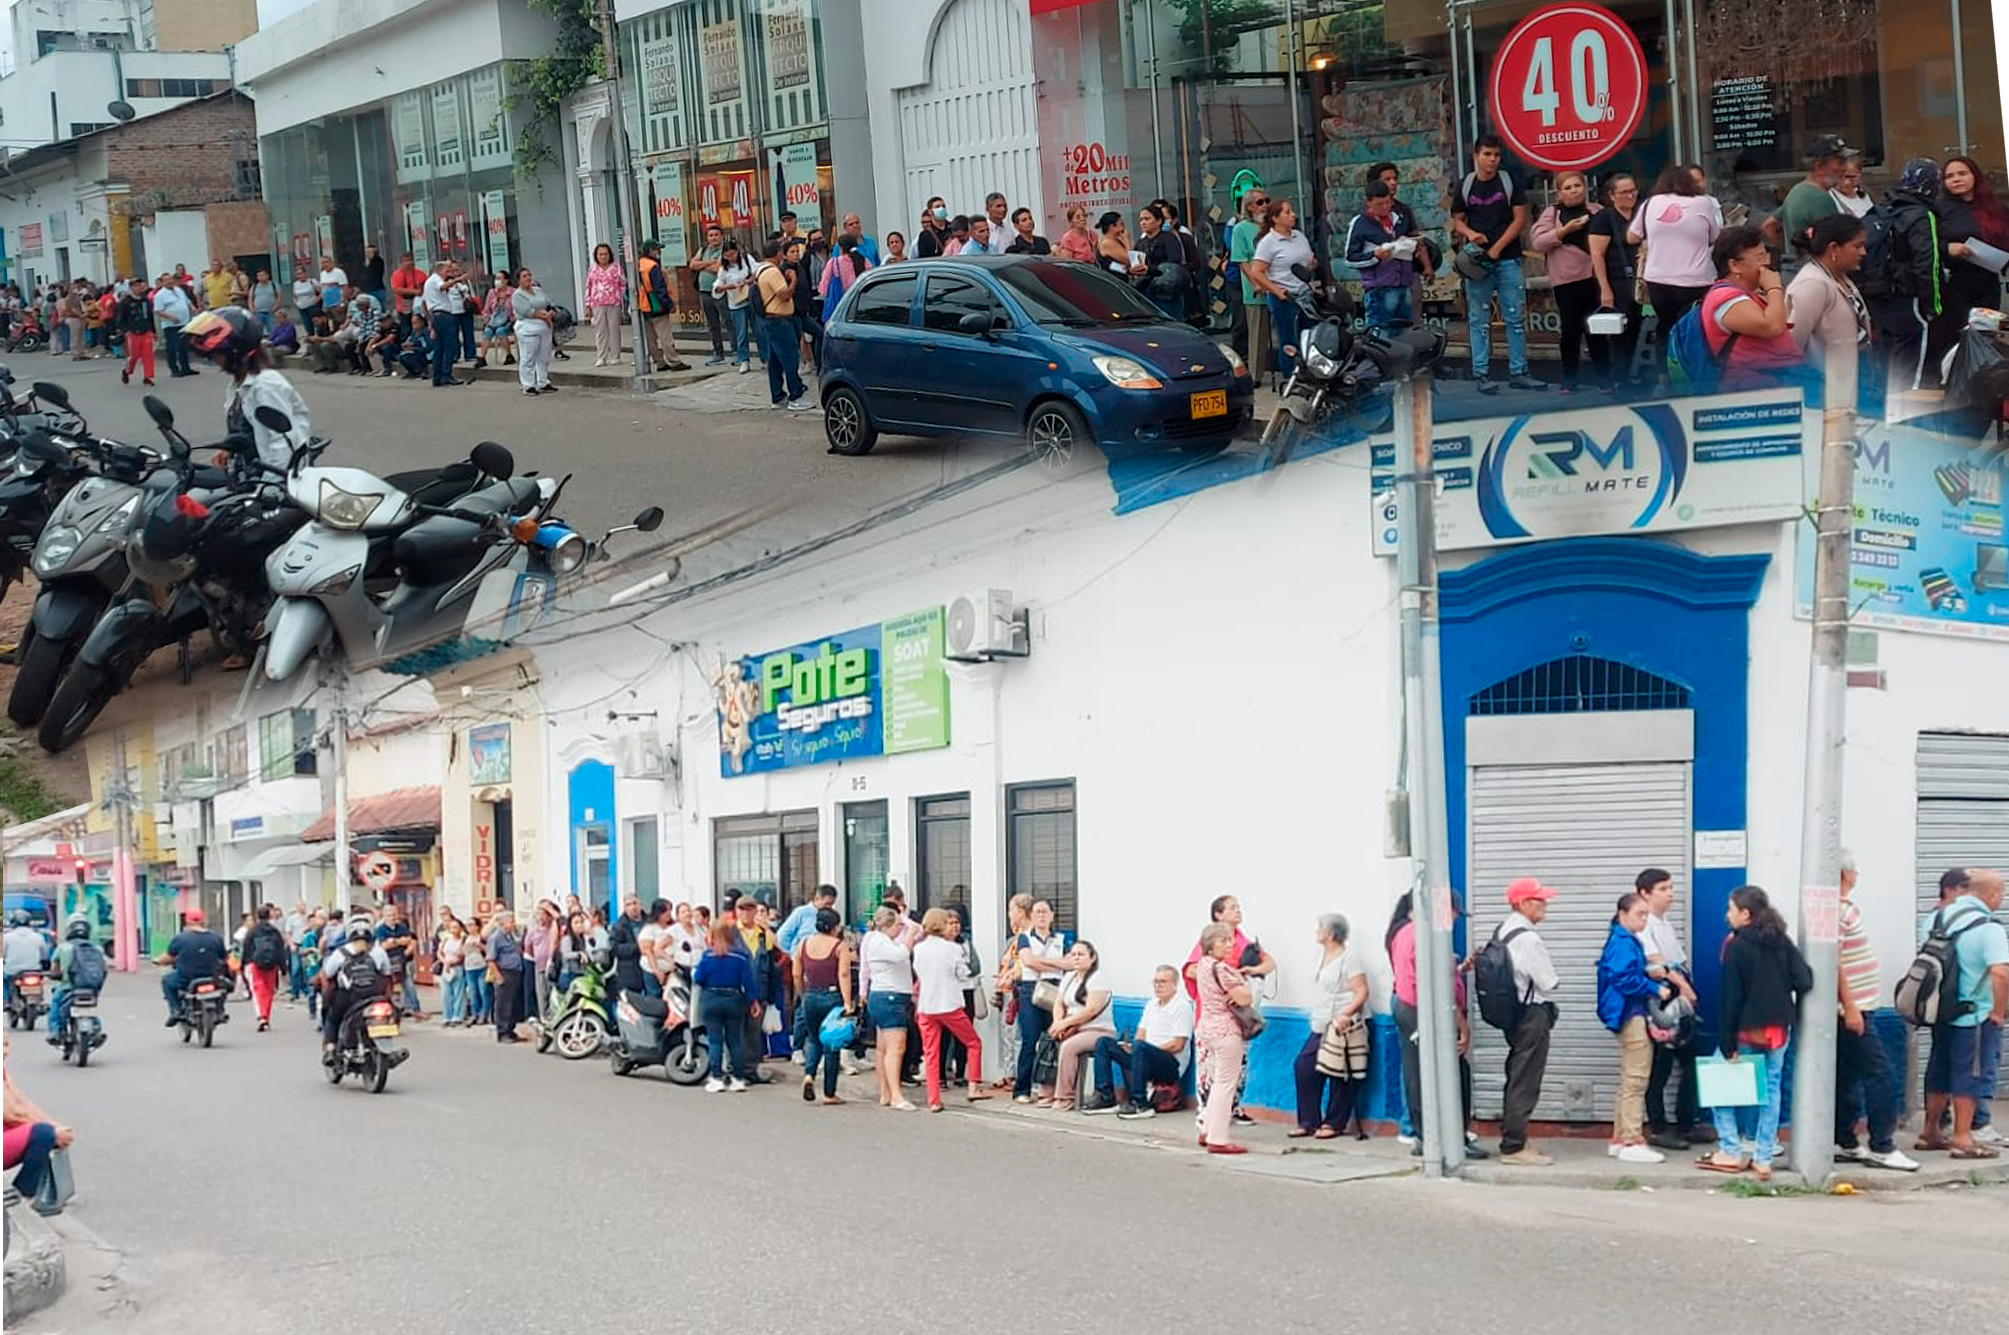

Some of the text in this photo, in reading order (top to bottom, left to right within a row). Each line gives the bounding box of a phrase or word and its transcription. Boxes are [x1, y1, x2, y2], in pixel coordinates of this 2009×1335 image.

[703, 27, 737, 44] Fernando
[769, 21, 805, 38] Solano
[644, 43, 674, 58] Fernando
[704, 40, 737, 56] Solano
[645, 54, 674, 69] Solano
[1713, 76, 1755, 87] HORARIO
[1719, 83, 1764, 94] ATENCIÓN
[1539, 129, 1599, 144] DESCUENTO
[1065, 163, 1075, 172] de
[1073, 142, 1106, 174] 20
[1106, 155, 1129, 172] Mil
[786, 182, 818, 206] 40%
[1066, 176, 1130, 195] Metros
[657, 197, 682, 218] 40%
[702, 184, 718, 221] 40
[733, 180, 749, 218] 40
[1697, 407, 1800, 423] INSTALACIÓN DE REDES
[1528, 426, 1634, 479] RM
[1512, 484, 1577, 499] REFILL
[1585, 475, 1650, 493] MATE
[1871, 508, 1920, 527] Técnico
[1861, 531, 1910, 548] Domicilio
[894, 637, 931, 662] SOAT
[762, 641, 868, 713] Pote
[776, 695, 872, 733] Seguros
